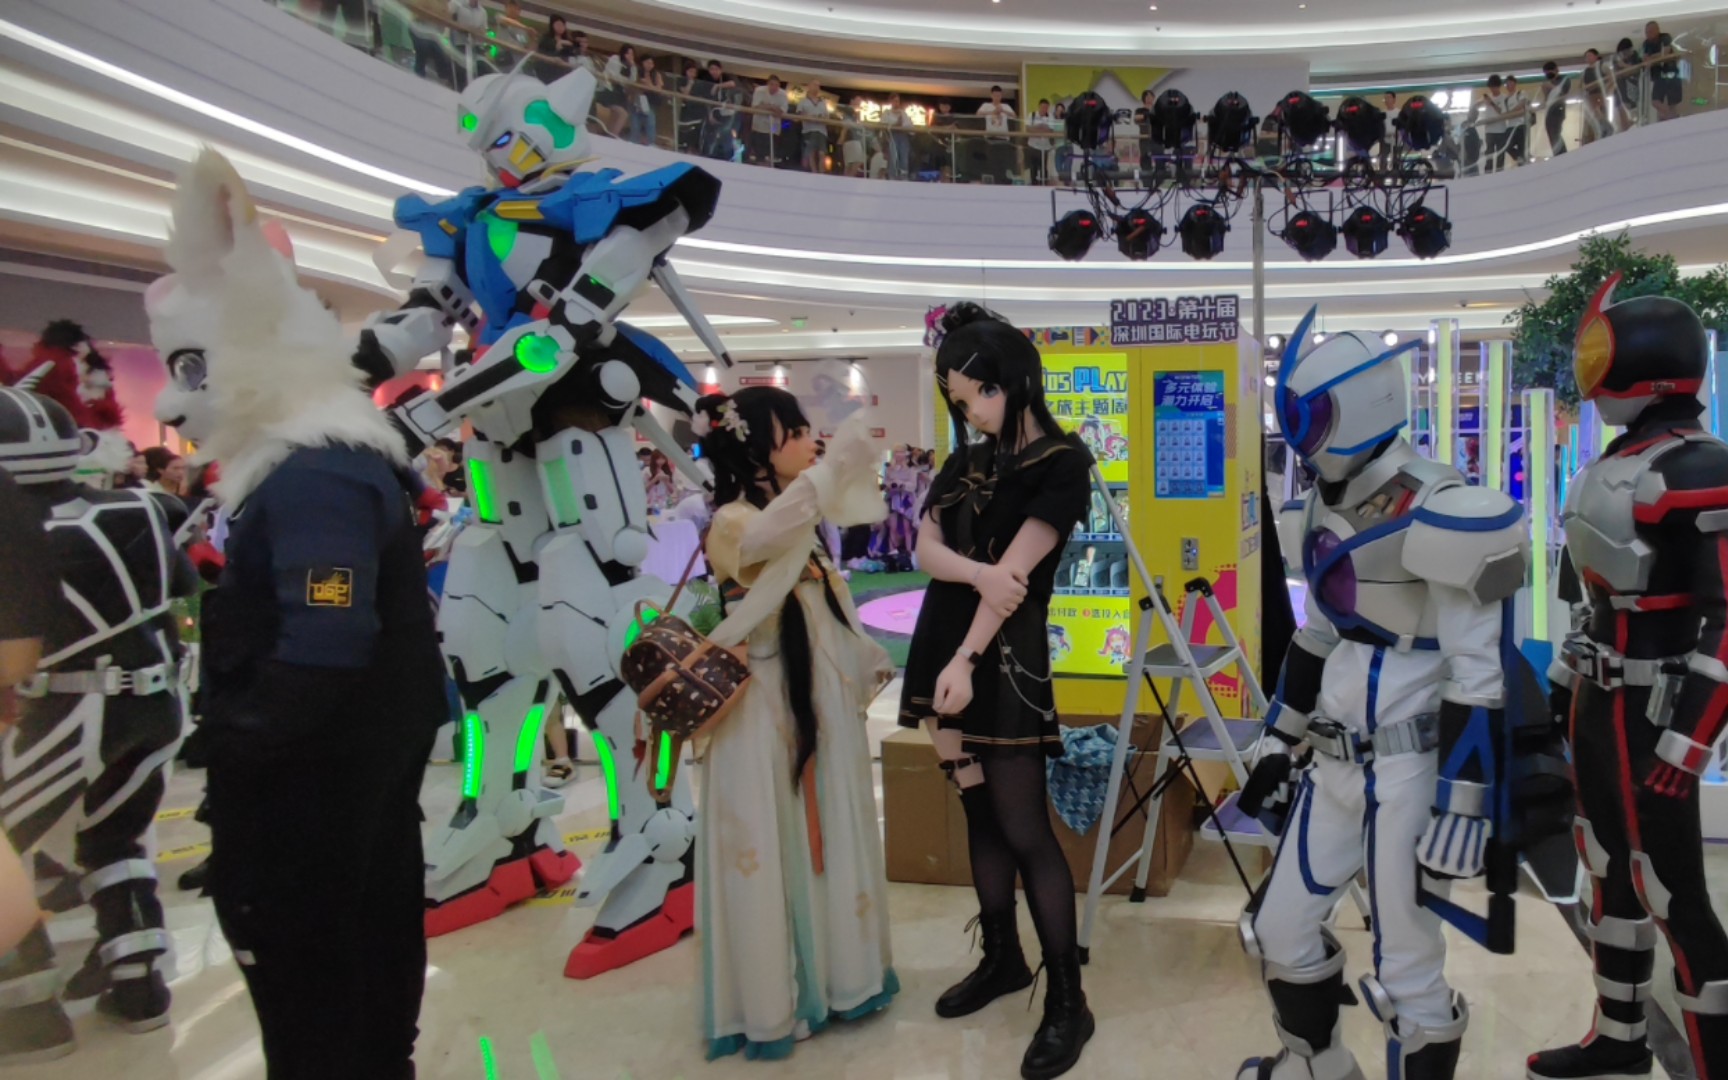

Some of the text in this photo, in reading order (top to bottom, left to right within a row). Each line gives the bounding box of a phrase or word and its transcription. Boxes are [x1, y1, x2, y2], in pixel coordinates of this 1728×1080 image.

[1113, 322, 1236, 342] 深圳国际电玩节
